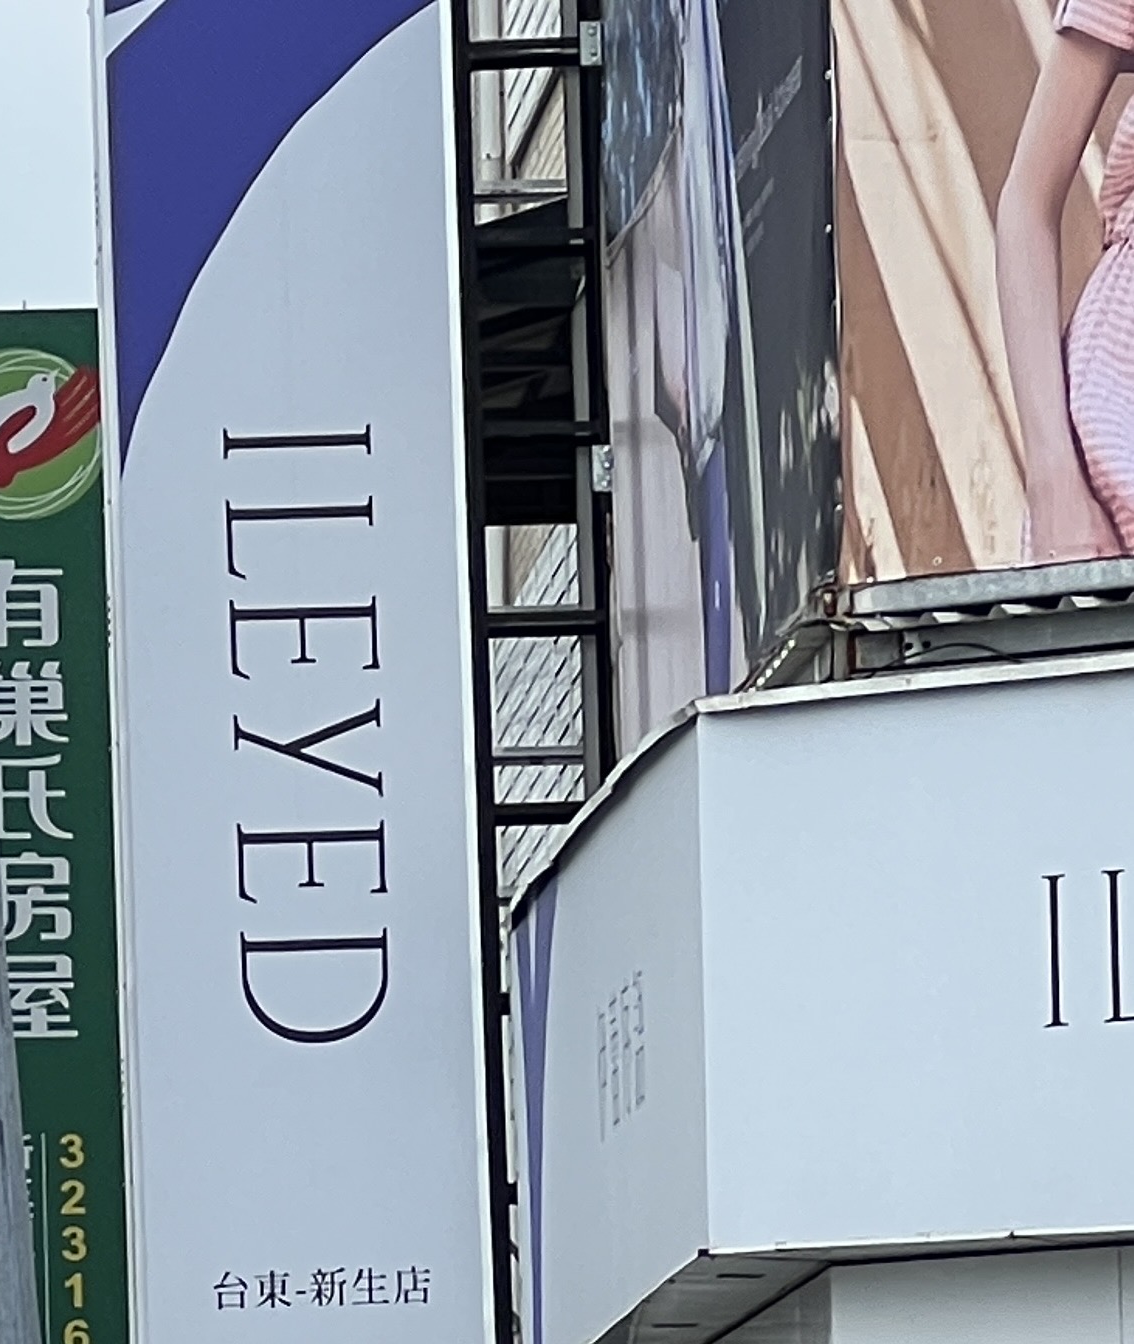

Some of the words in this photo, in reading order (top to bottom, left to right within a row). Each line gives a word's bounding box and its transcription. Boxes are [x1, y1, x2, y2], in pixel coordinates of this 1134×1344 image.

[222, 423, 390, 1044] ILEYED
[212, 1265, 432, 1312] 台東-新生店
